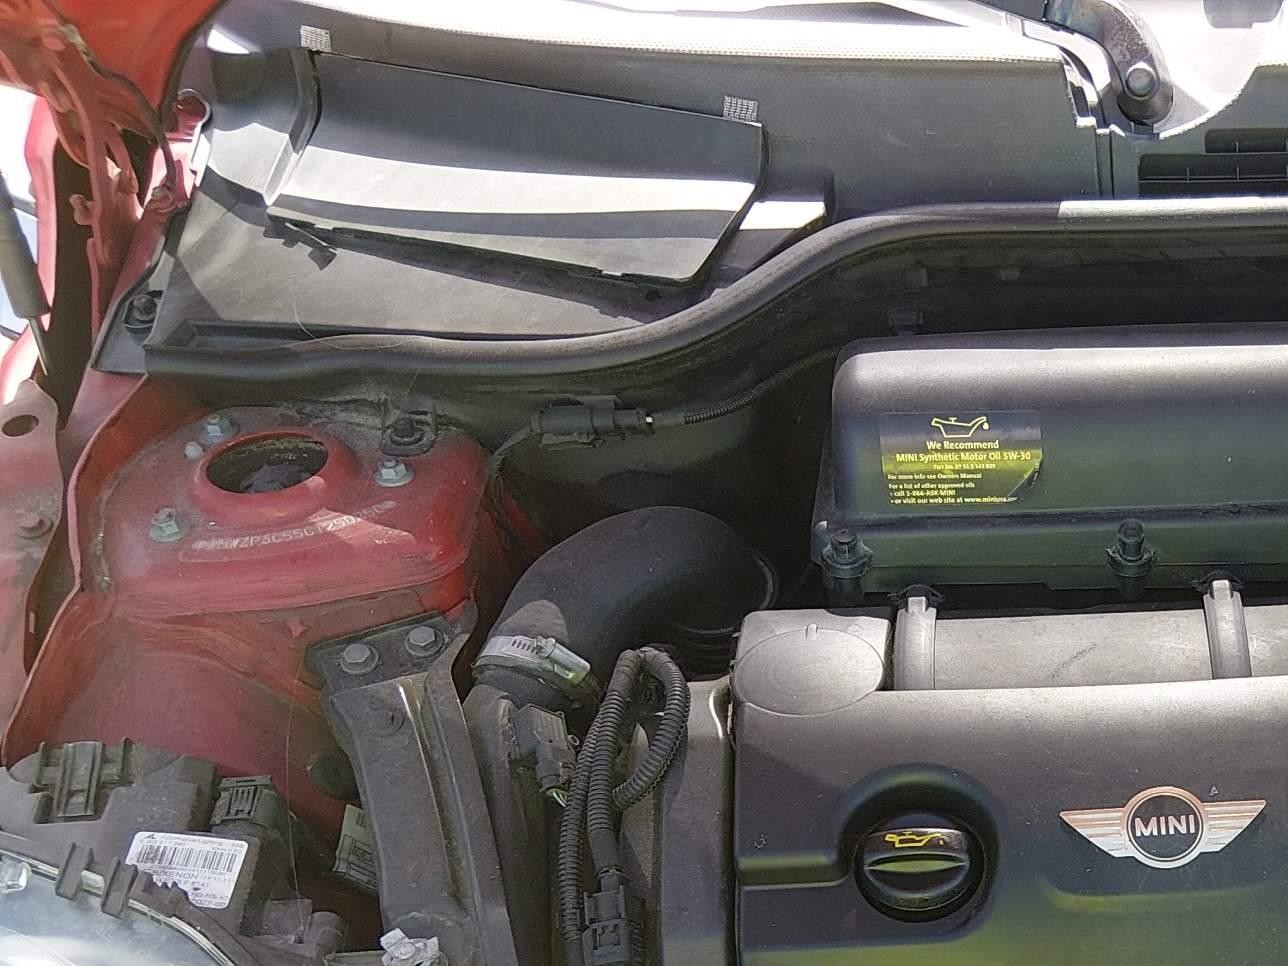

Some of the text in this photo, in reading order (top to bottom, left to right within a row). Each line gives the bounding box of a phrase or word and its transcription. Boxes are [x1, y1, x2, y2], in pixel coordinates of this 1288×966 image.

[926, 439, 1000, 450] We Recommend
[895, 451, 1031, 464] MINI Synthetic Motor Oil 5W-30
[1134, 813, 1196, 837] MINI
